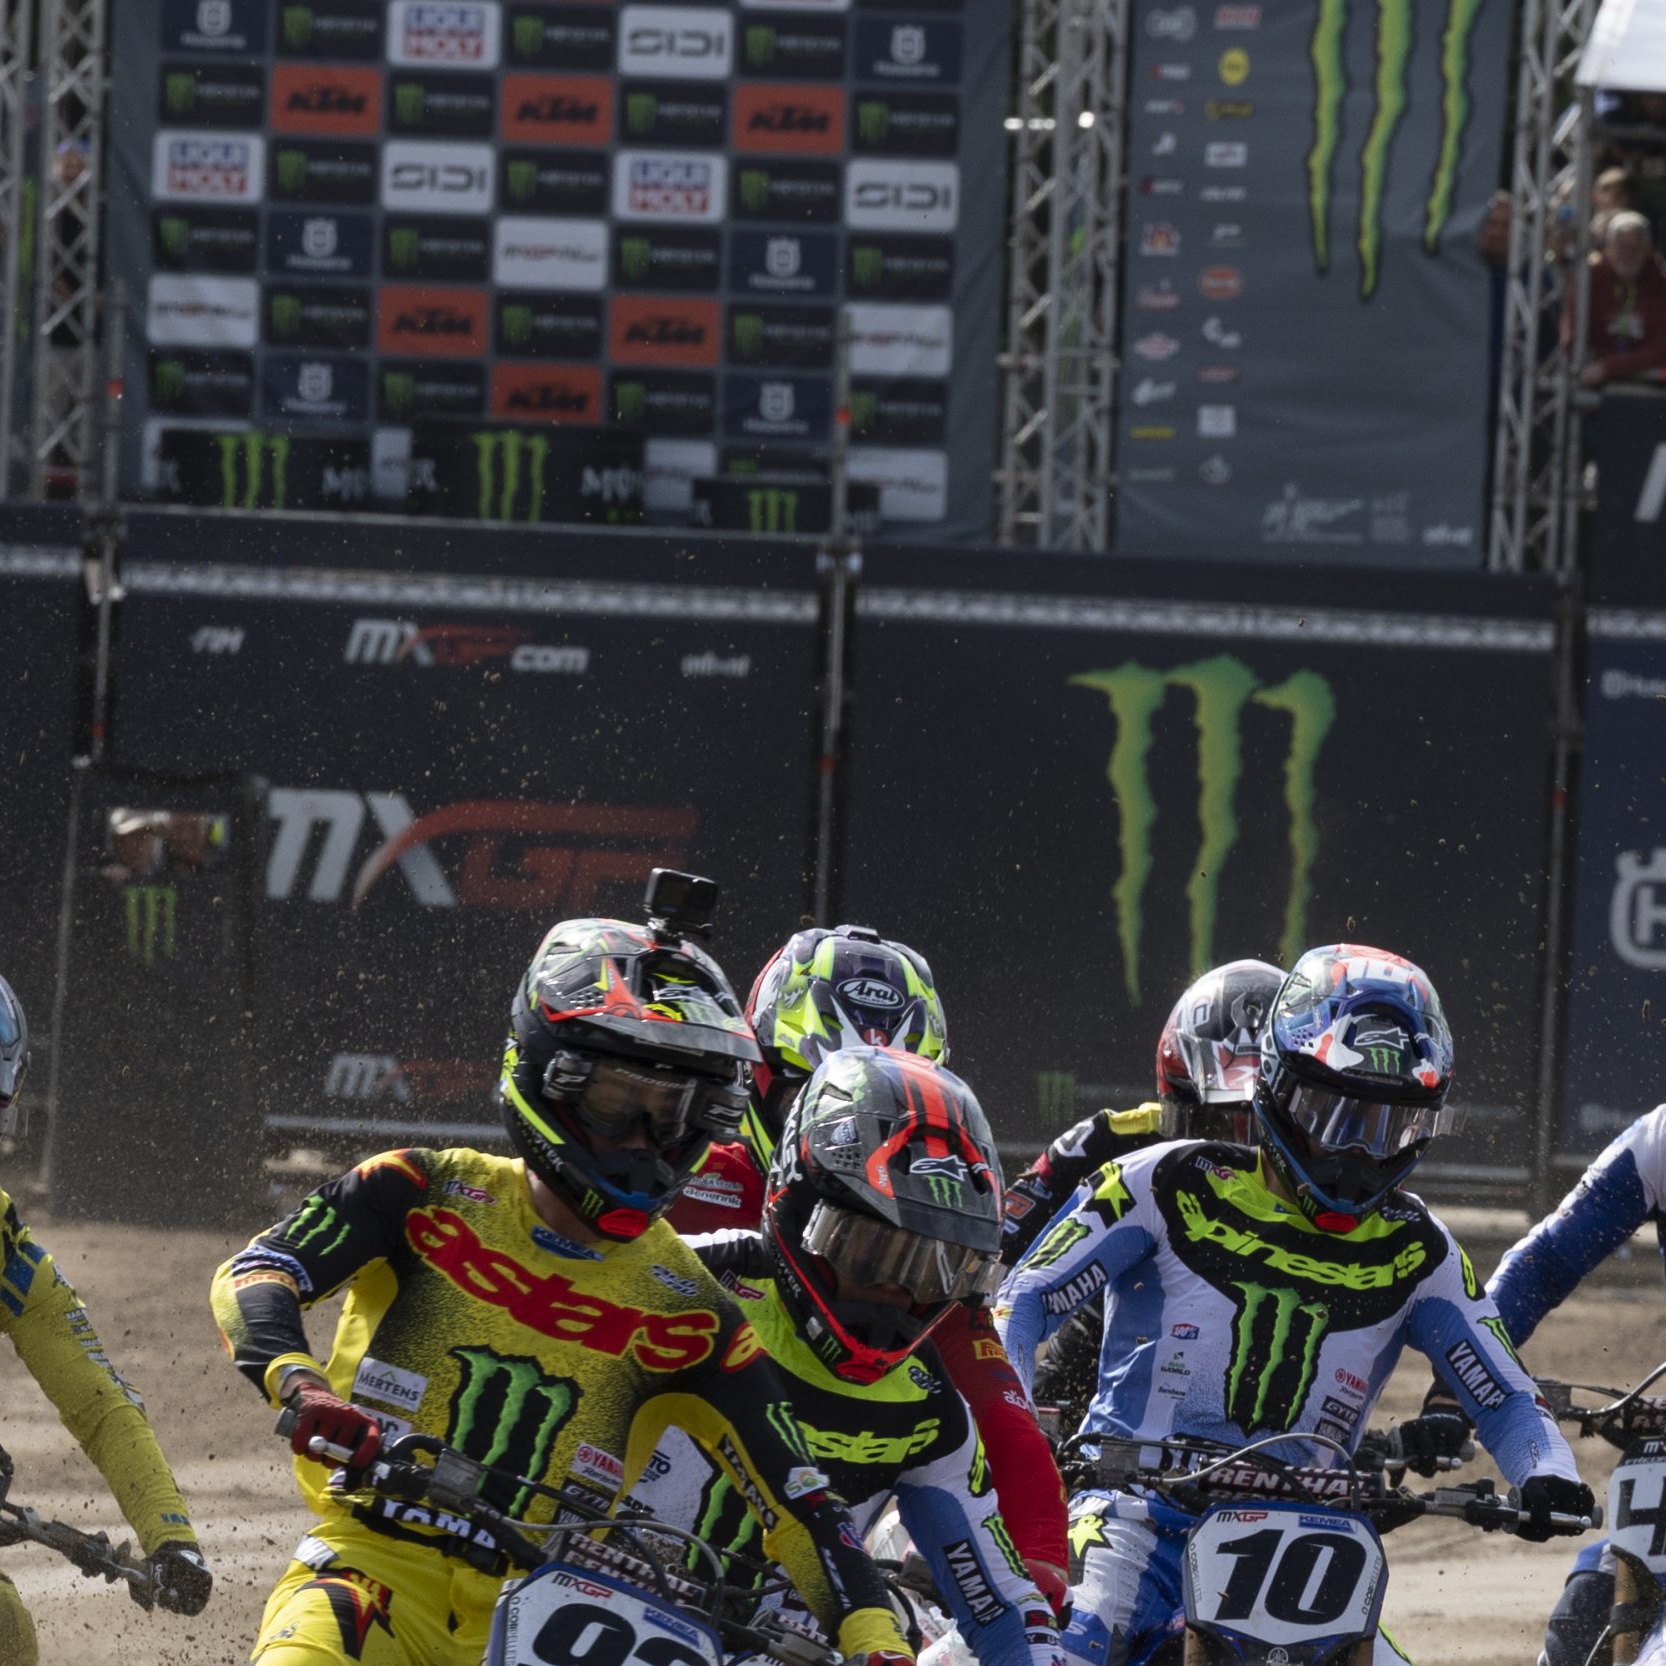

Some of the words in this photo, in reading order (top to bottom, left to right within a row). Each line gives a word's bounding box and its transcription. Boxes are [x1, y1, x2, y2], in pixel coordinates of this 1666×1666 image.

[627, 29, 725, 58] SIDI
[391, 163, 486, 191] SIDI
[854, 183, 951, 210] SIDI
[843, 978, 899, 1007] Arai
[357, 1369, 422, 1402] MERTENS
[1216, 1511, 1270, 1523] MXGP
[1299, 1514, 1354, 1529] KEMEA
[552, 1571, 614, 1600] MXGP
[1215, 1528, 1368, 1626] 10
